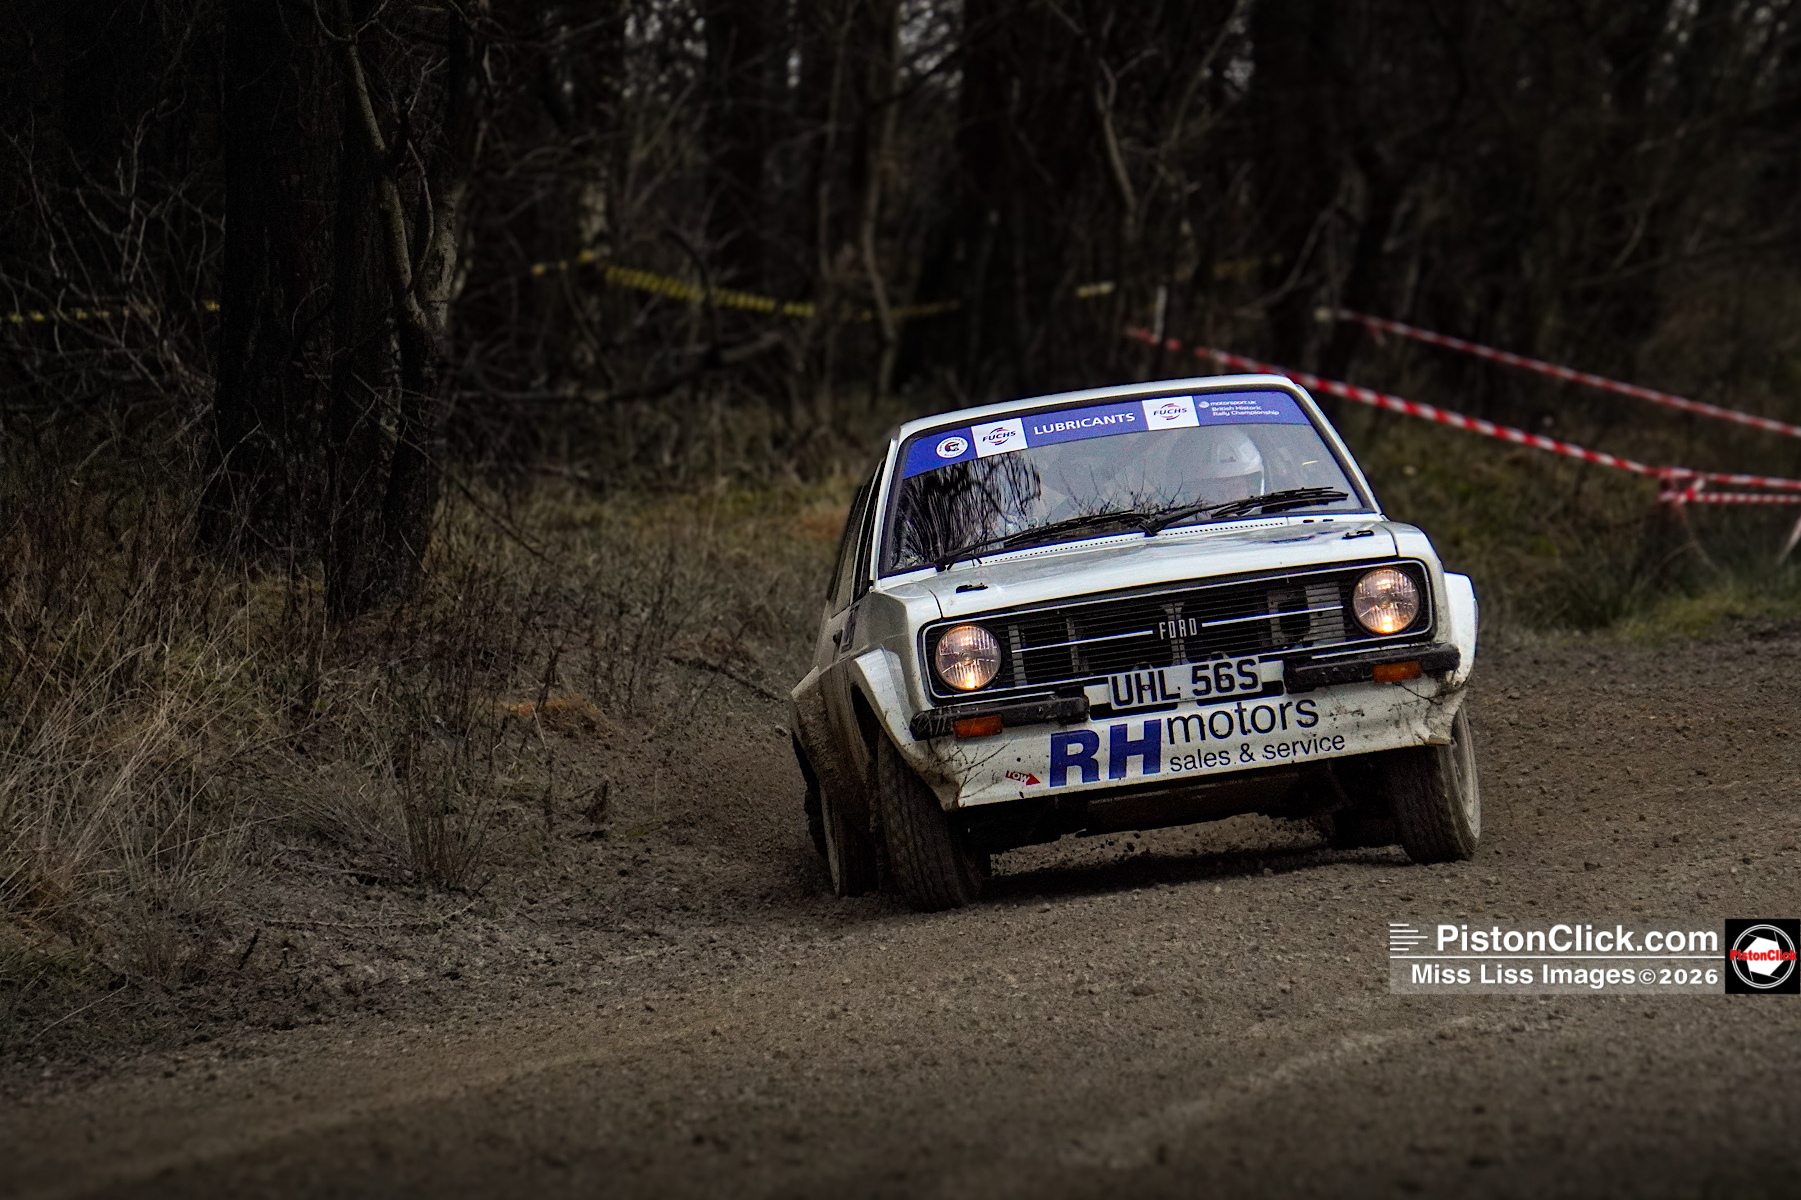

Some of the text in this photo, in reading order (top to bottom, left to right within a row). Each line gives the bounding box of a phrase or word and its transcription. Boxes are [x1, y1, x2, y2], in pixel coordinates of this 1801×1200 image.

[982, 407, 1188, 442] FUCHS LUBRICANTS FUCHS
[1158, 617, 1198, 640] FORD
[1111, 658, 1259, 707] UHL 56S
[1166, 699, 1320, 745] motors
[1050, 718, 1162, 787] RH
[1169, 733, 1346, 772] sales & service
